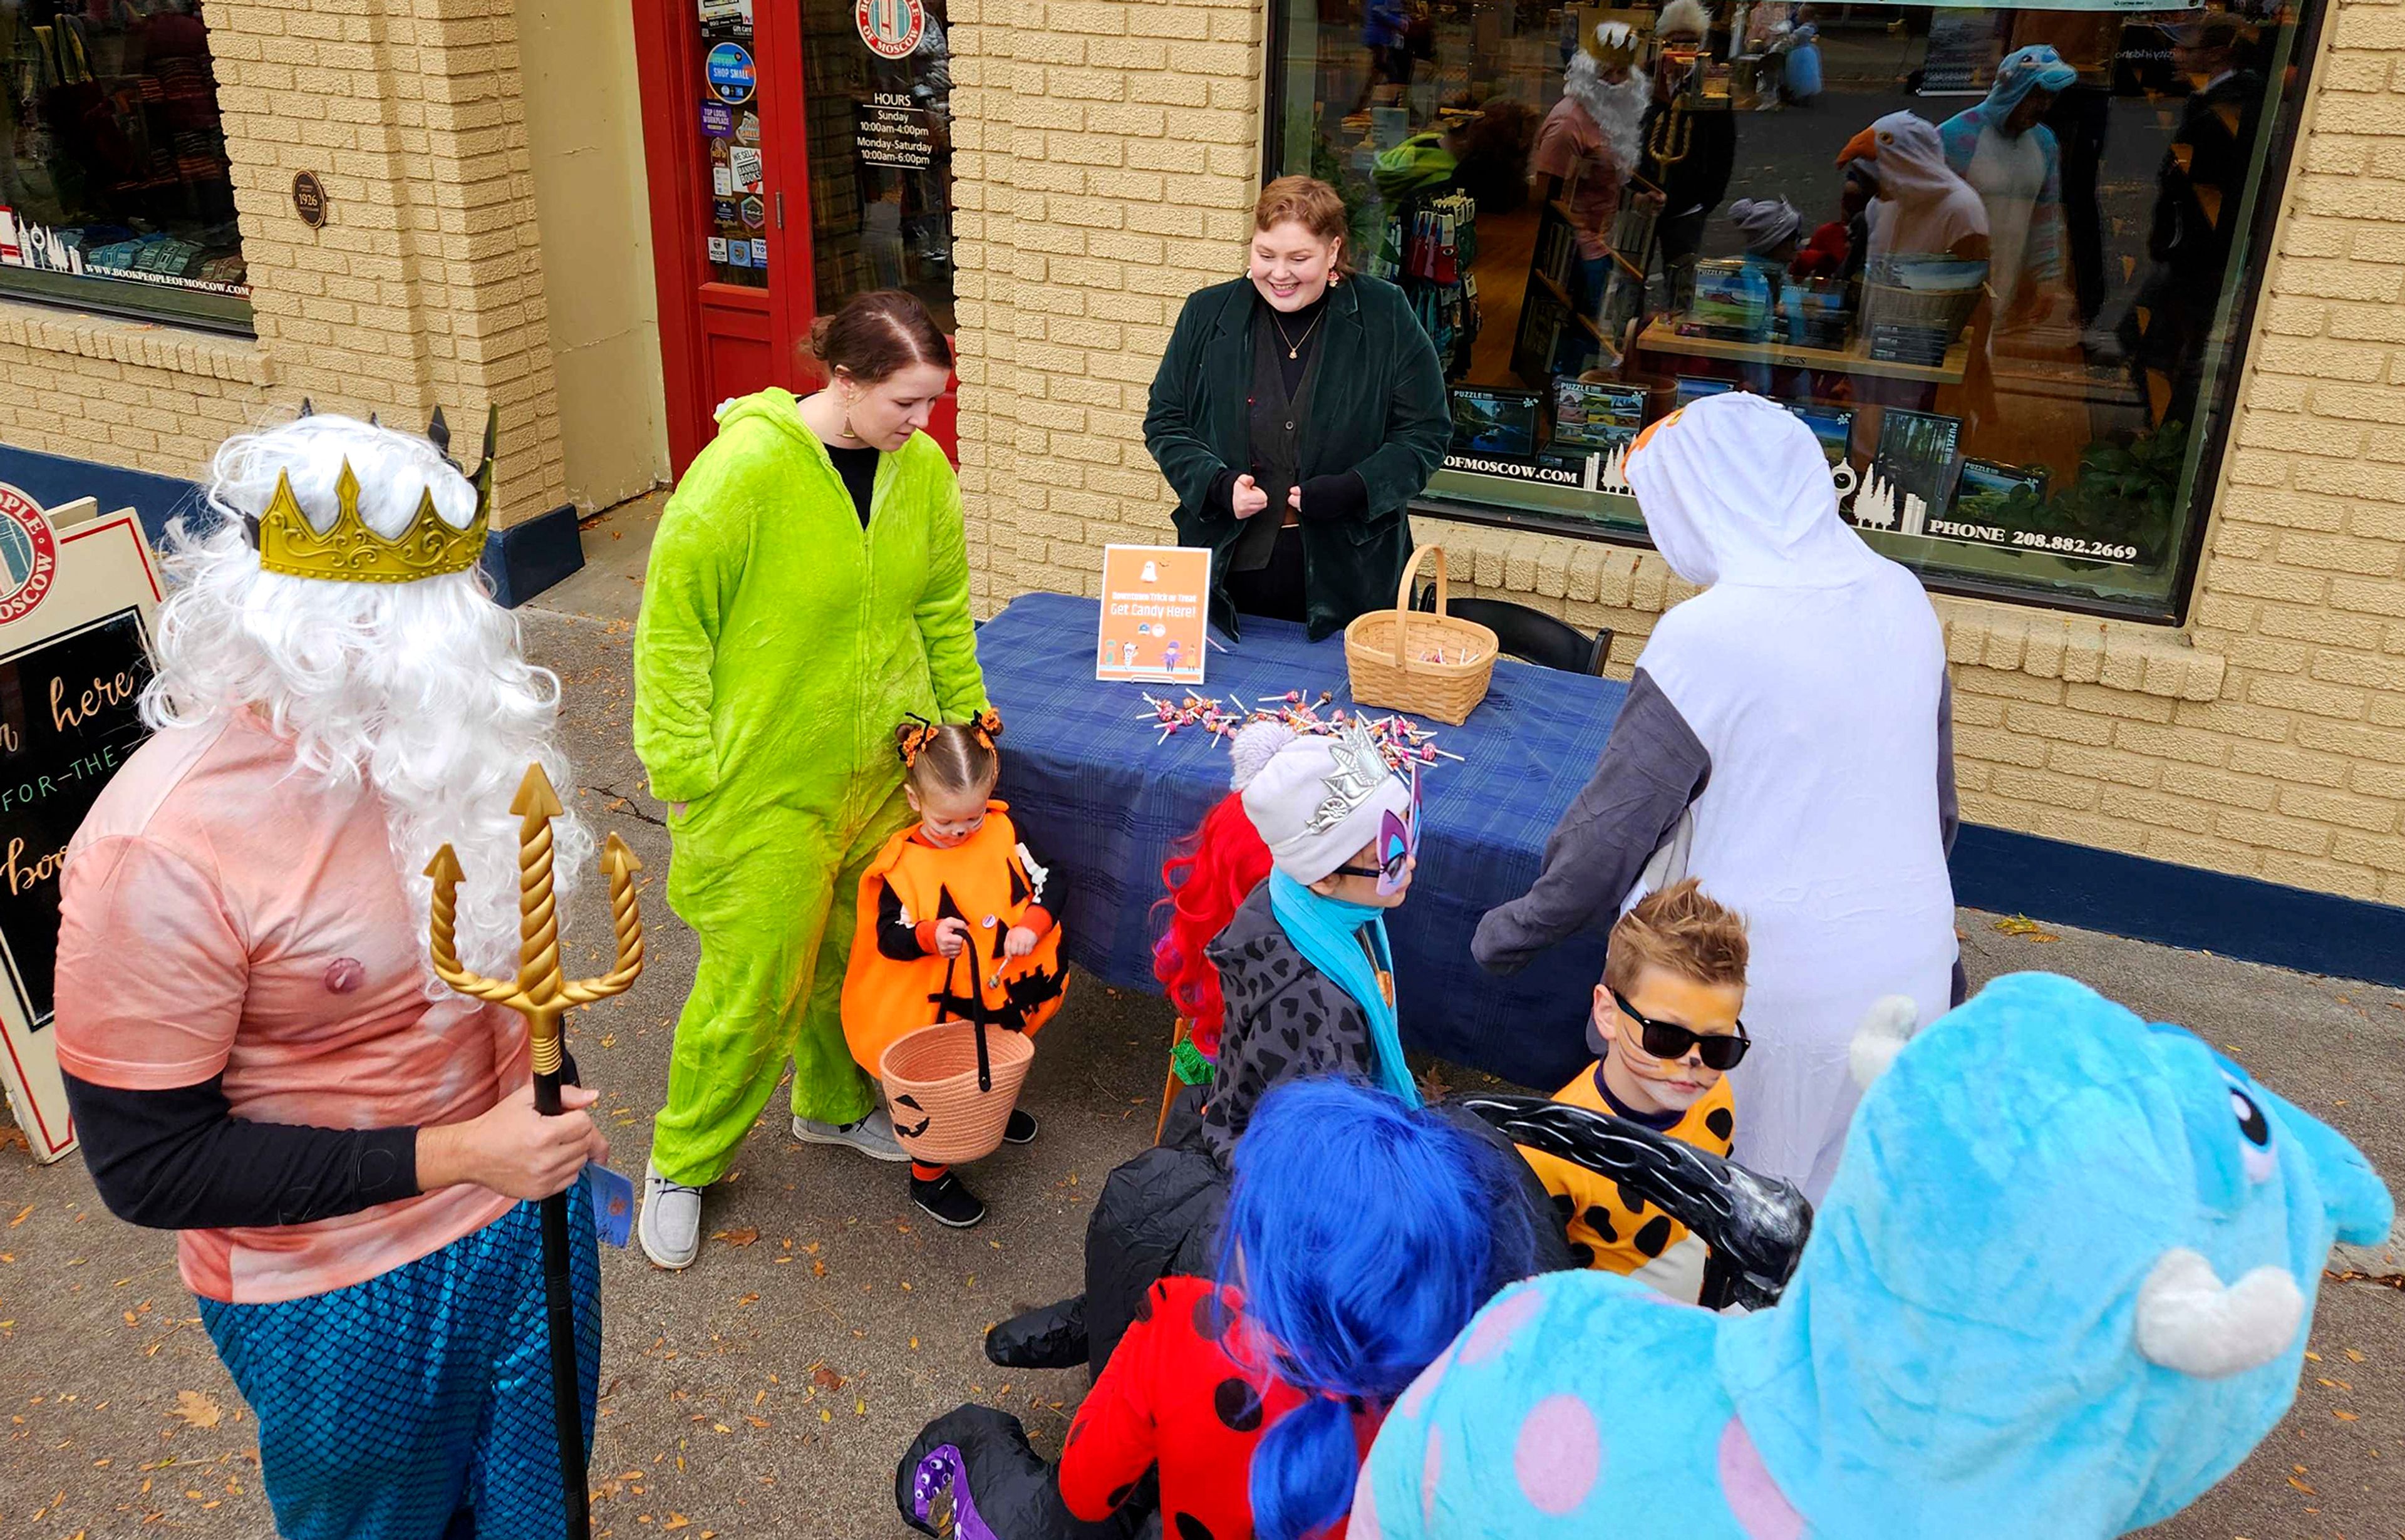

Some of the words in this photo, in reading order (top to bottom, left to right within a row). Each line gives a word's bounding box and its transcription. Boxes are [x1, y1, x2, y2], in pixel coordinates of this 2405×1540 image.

[876, 26, 919, 53] MOSCOW
[713, 67, 729, 78] SHOP
[730, 68, 750, 80] SMALL
[874, 92, 911, 106] HOURS
[704, 108, 713, 116] TOP
[877, 110, 909, 124] Sunday
[860, 121, 929, 138] 10:00am-4:00pm
[857, 136, 933, 155] Monday-Saturday
[861, 149, 931, 166] 10:00am-6:00pm
[299, 193, 318, 207] 1926
[85, 263, 249, 296] WWW.BOOKPEOPLEOFMOSCOW.COM
[1454, 390, 1483, 400] PUZZLE
[1559, 382, 1590, 393] PUZZLE
[1945, 421, 1958, 453] PUZZLE
[1965, 462, 1990, 473] PUZZLE
[1928, 519, 2006, 543] PHONE
[2011, 530, 2138, 560] 208.882.2669
[1110, 602, 1129, 615] Get
[1131, 604, 1164, 619] Candy
[1166, 606, 1196, 618] Here!
[49, 671, 134, 732] here
